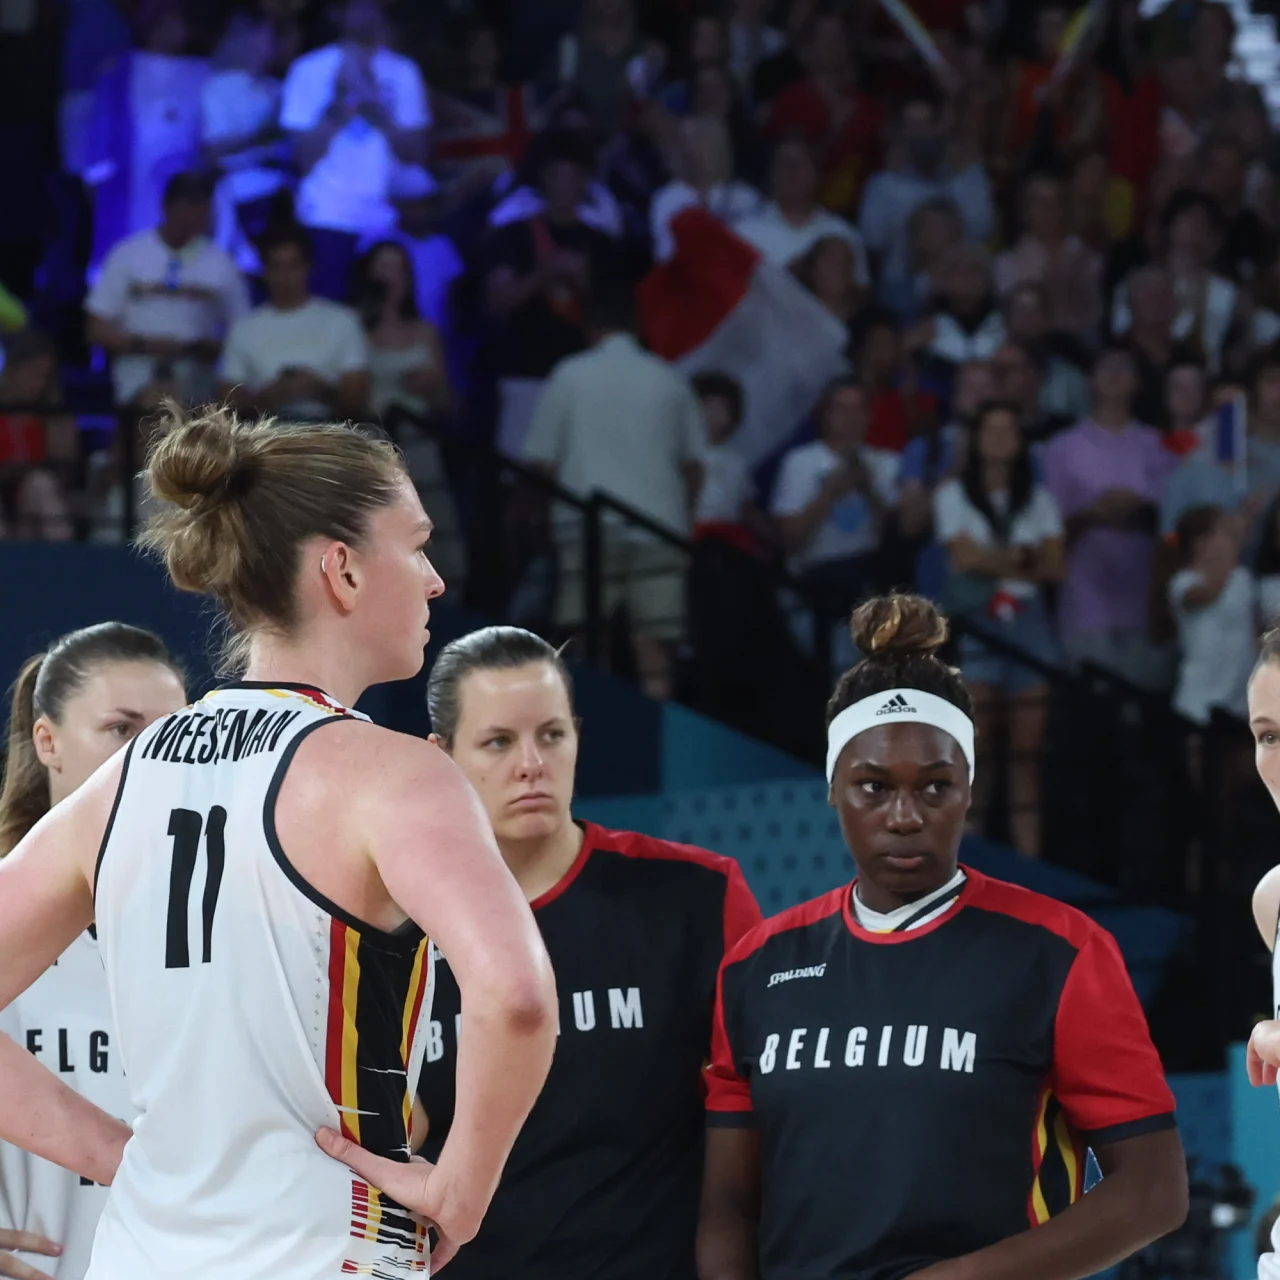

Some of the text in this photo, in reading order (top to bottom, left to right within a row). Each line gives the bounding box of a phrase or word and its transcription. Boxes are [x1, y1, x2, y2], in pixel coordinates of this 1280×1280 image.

[875, 705, 918, 716] adidas
[165, 804, 228, 969] 11
[767, 963, 827, 988] SPALDING
[759, 1024, 977, 1074] BELGIUM
